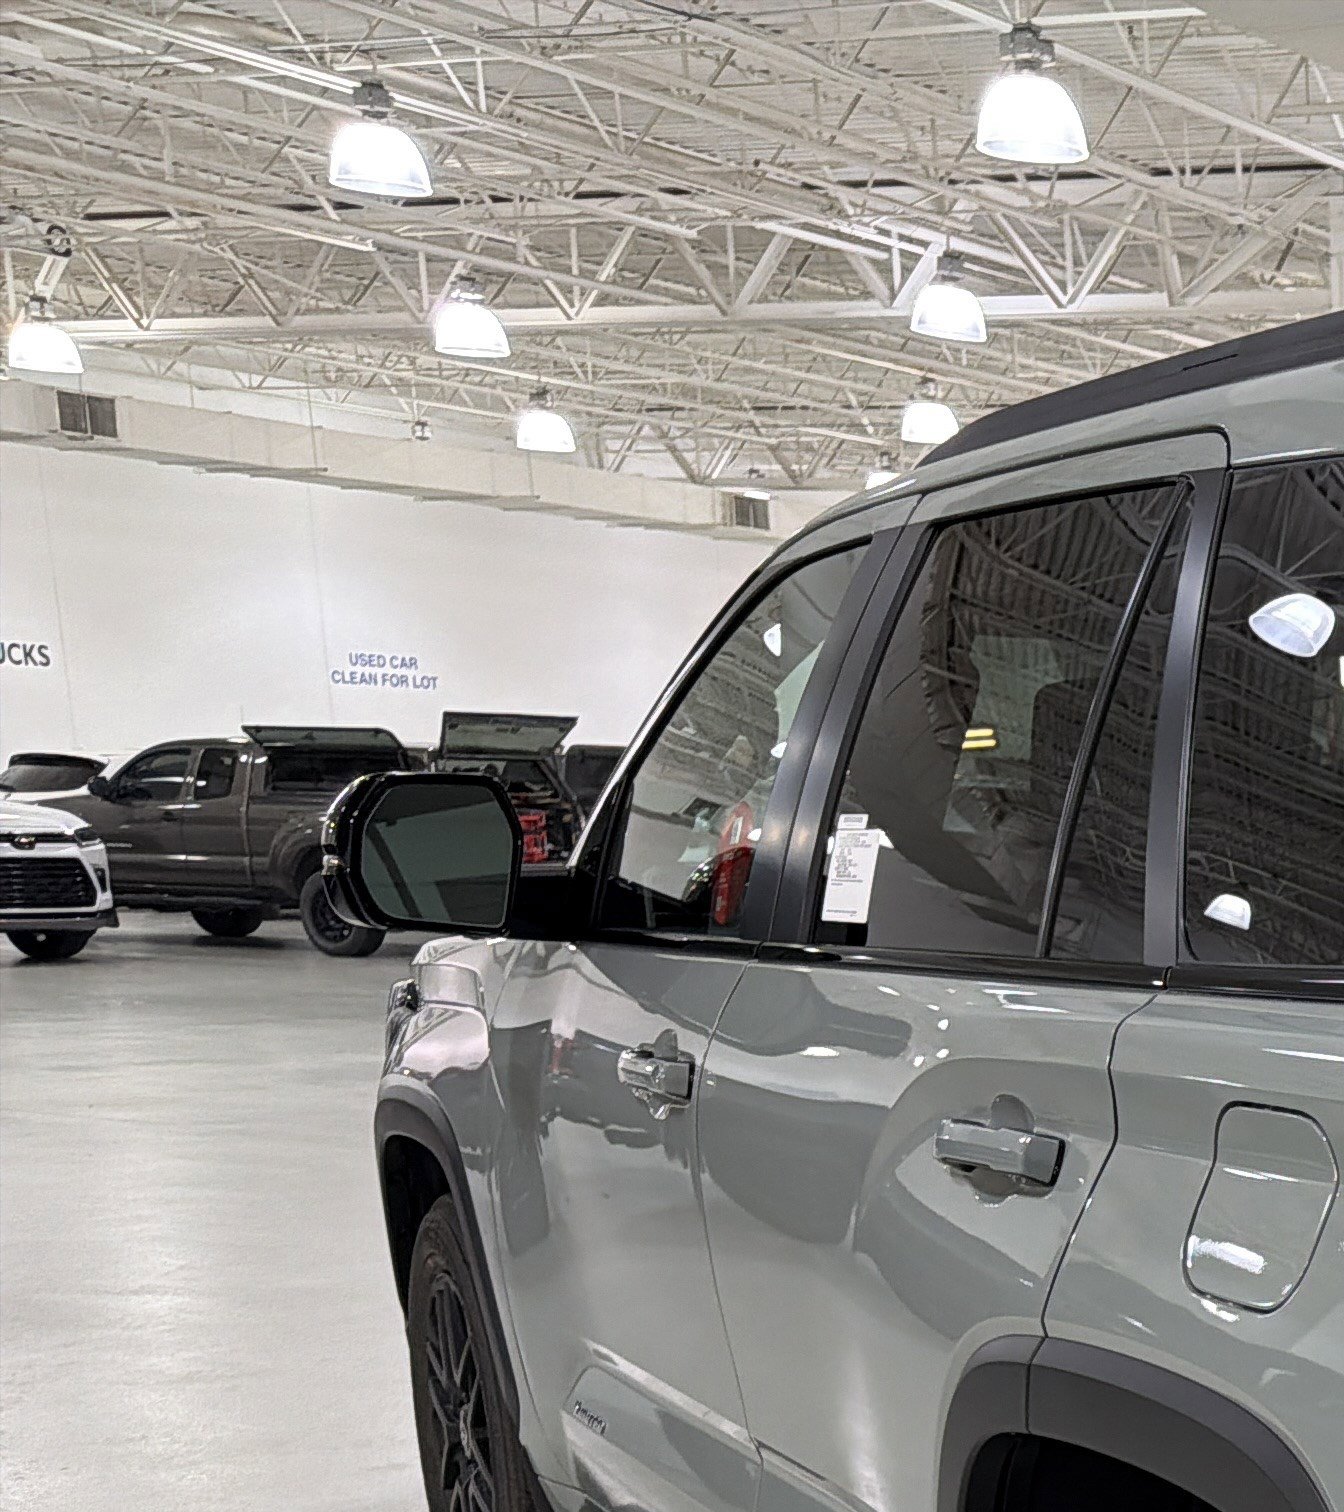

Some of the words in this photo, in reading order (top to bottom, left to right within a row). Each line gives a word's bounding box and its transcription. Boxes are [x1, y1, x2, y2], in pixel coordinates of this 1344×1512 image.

[348, 652, 387, 668] USED
[389, 655, 419, 670] CAR
[331, 669, 379, 686] CLEAN
[381, 672, 409, 688] FOR
[412, 674, 438, 690] LOT
